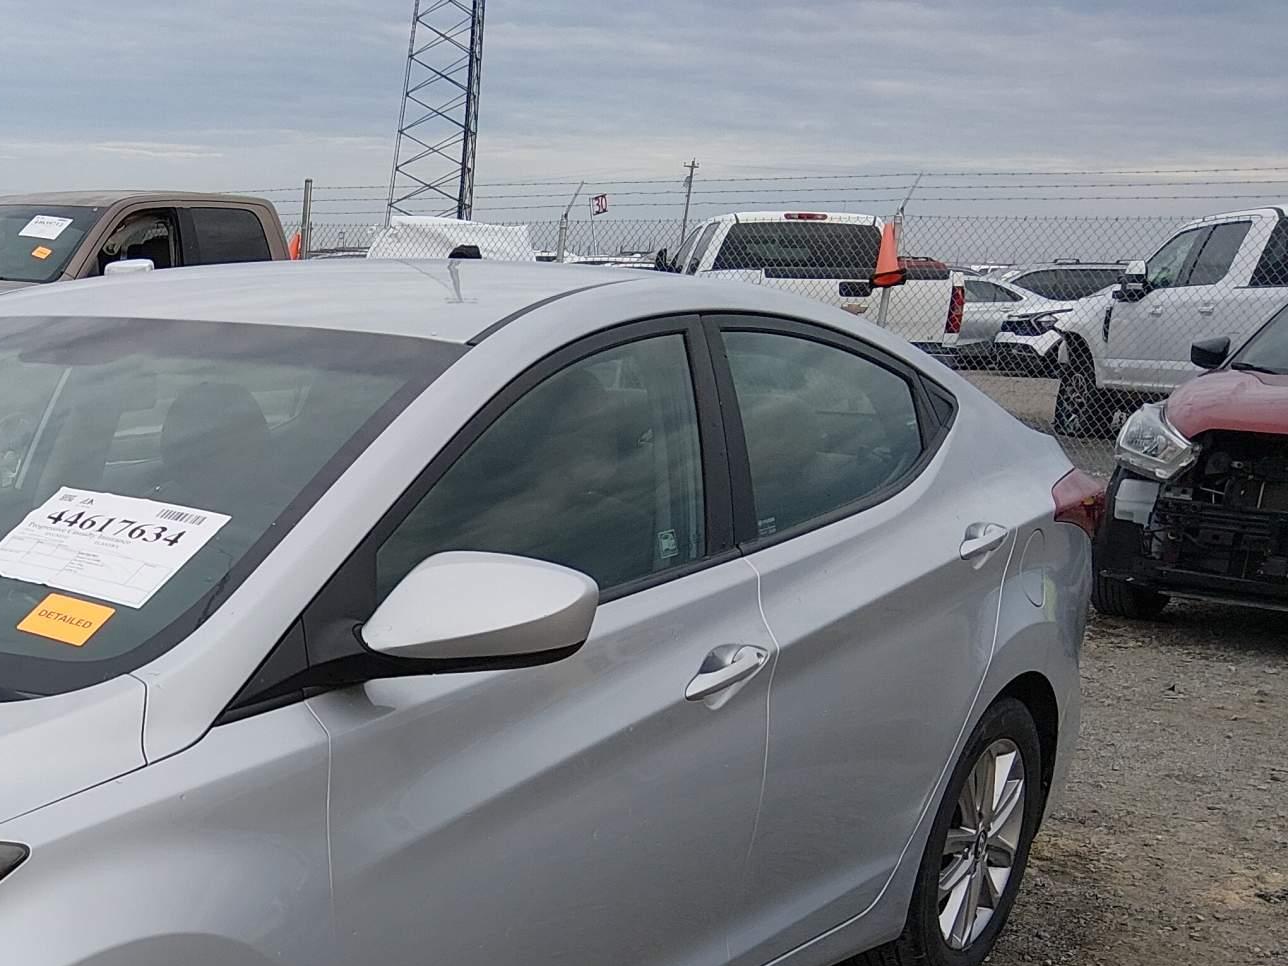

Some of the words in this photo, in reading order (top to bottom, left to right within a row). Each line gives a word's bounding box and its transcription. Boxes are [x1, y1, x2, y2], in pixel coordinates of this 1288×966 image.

[594, 195, 608, 214] 30
[47, 510, 186, 546] 44617634
[38, 609, 93, 629] DETAILED
